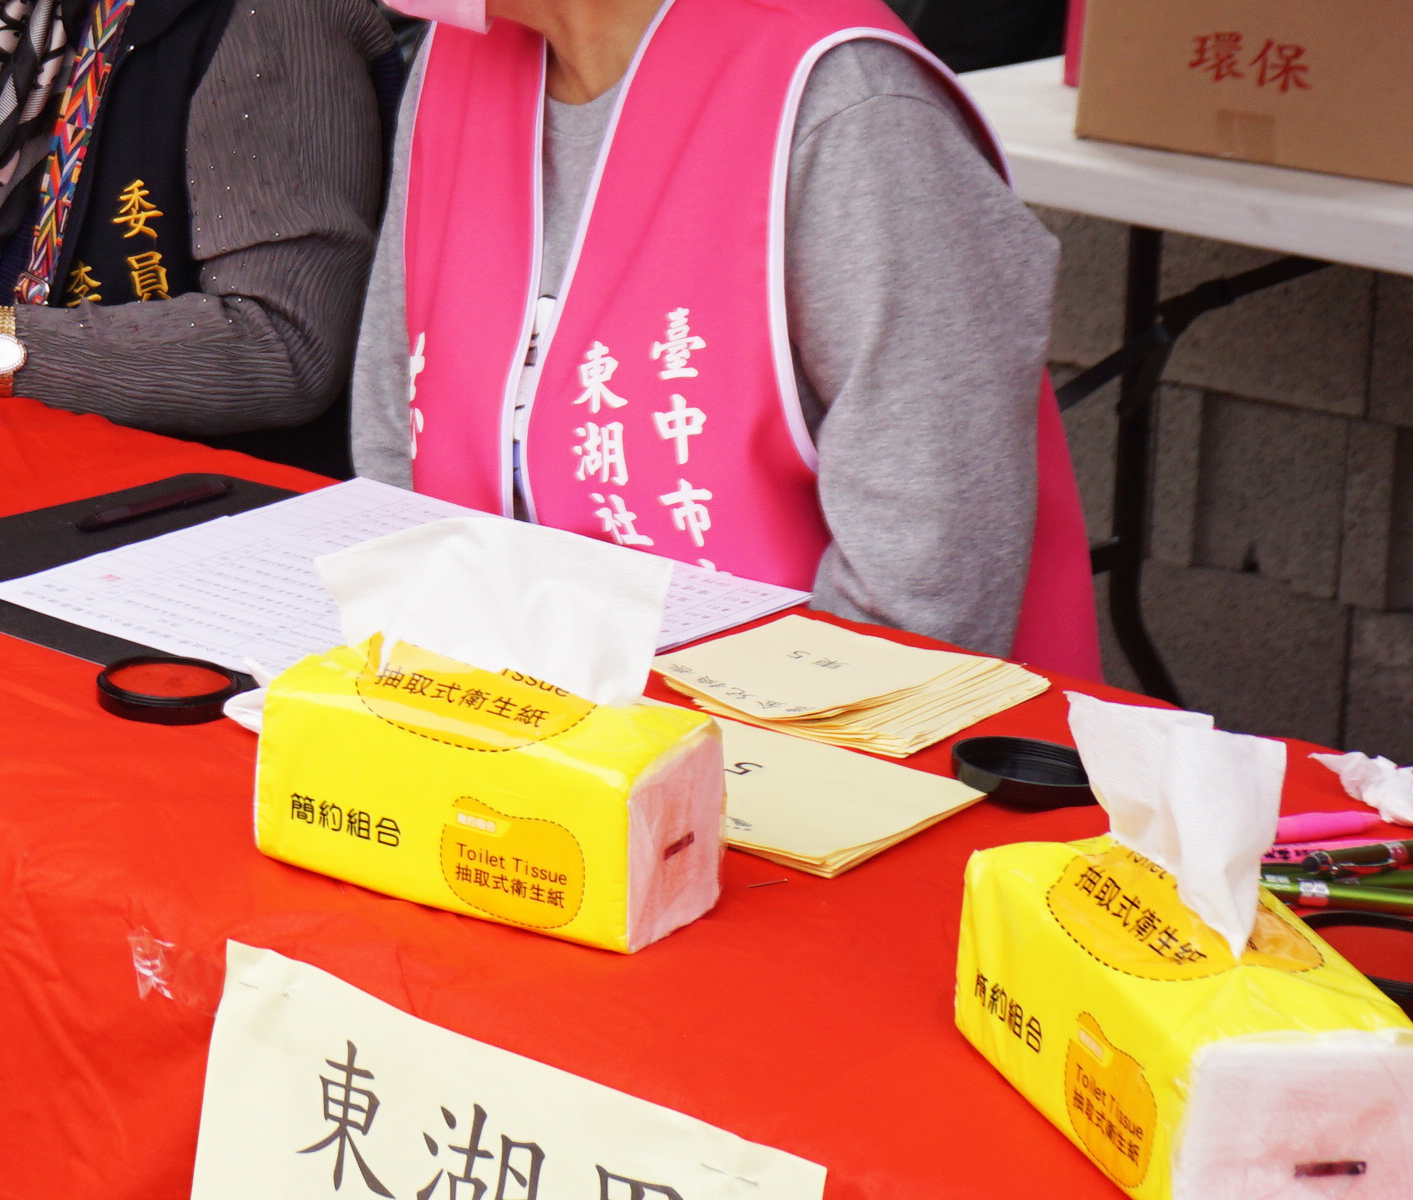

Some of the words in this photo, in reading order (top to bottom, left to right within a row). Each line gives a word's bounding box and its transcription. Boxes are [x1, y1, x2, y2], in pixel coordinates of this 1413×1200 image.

[1188, 31, 1313, 94] 環保
[113, 179, 173, 302] 委員
[573, 341, 654, 548] 東湖社
[651, 307, 731, 577] 臺中市
[374, 662, 551, 729] 抽取式衛生紙
[499, 667, 571, 698] issue
[290, 791, 401, 848] 簡約組合
[455, 863, 565, 910] 抽取式衛生紙
[456, 842, 507, 870] Toilet
[511, 857, 568, 886] Tissue
[295, 1040, 685, 1200] 東湖
